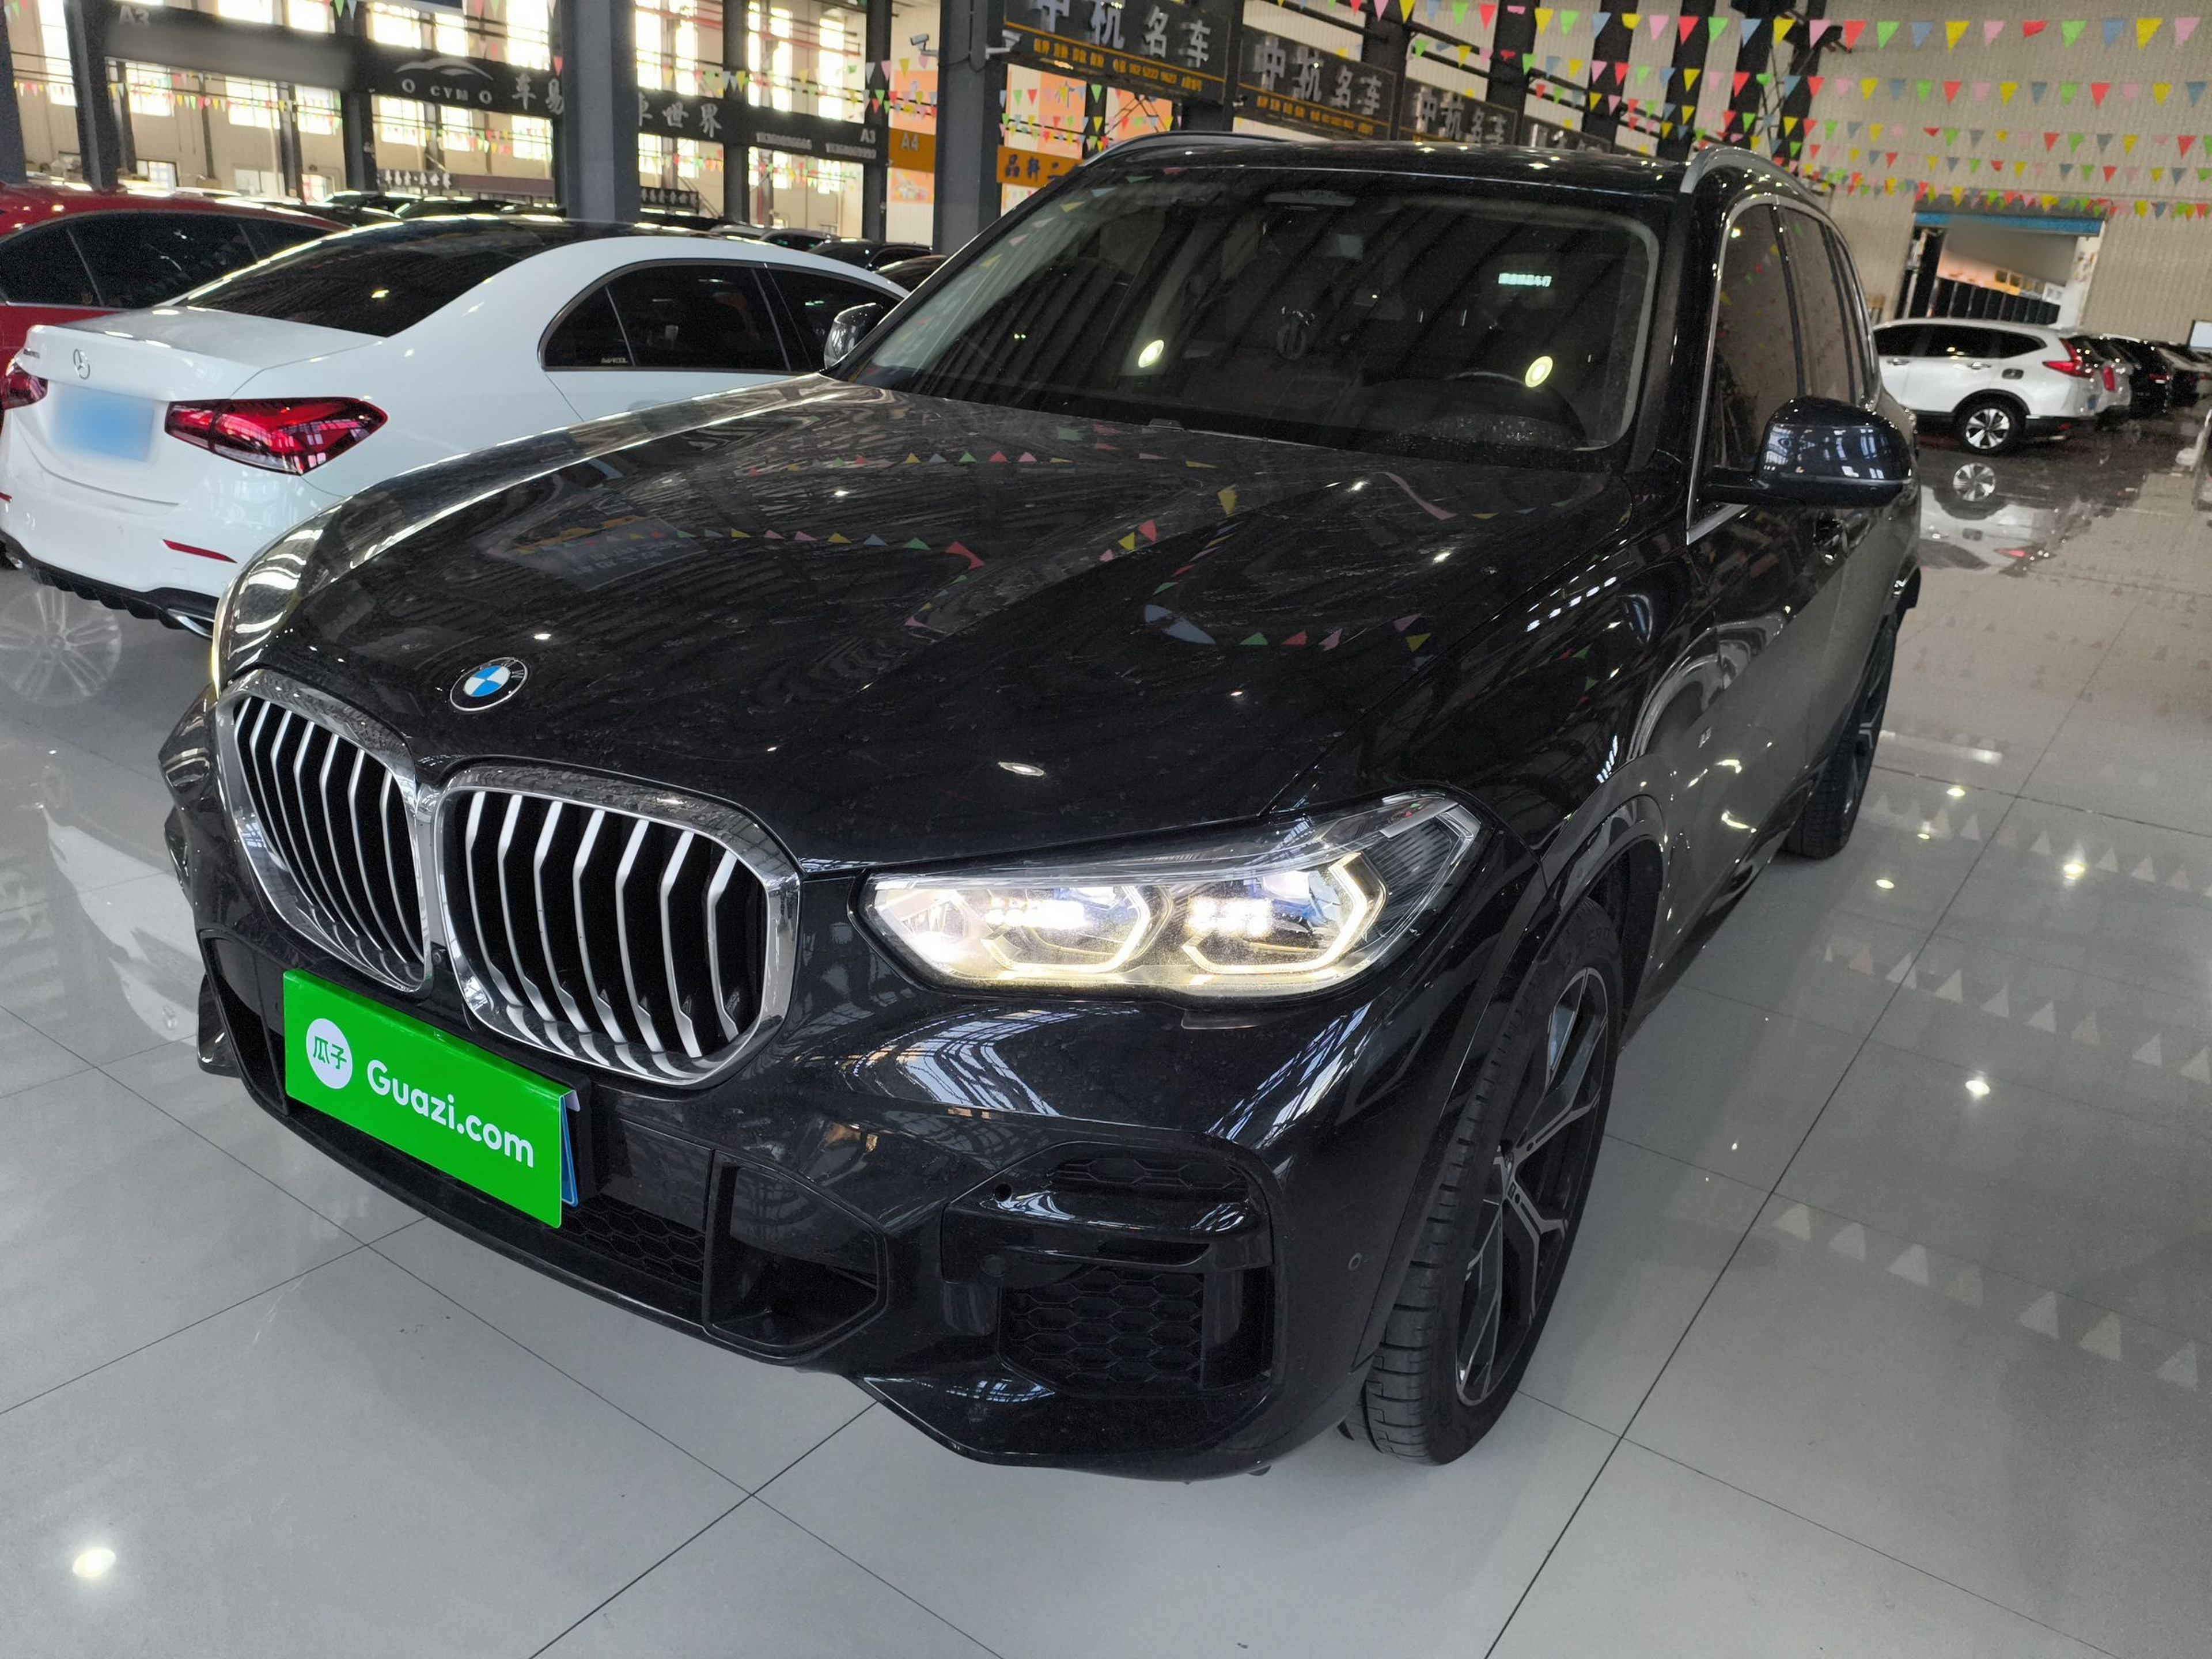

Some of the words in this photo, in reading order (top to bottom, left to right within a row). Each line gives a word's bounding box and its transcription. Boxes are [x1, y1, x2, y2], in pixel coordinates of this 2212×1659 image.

[118, 5, 150, 28] A3
[860, 128, 876, 144] A3
[900, 132, 919, 151] A4
[312, 1035, 347, 1070] 瓜子
[367, 1059, 534, 1168] Guazi.com
